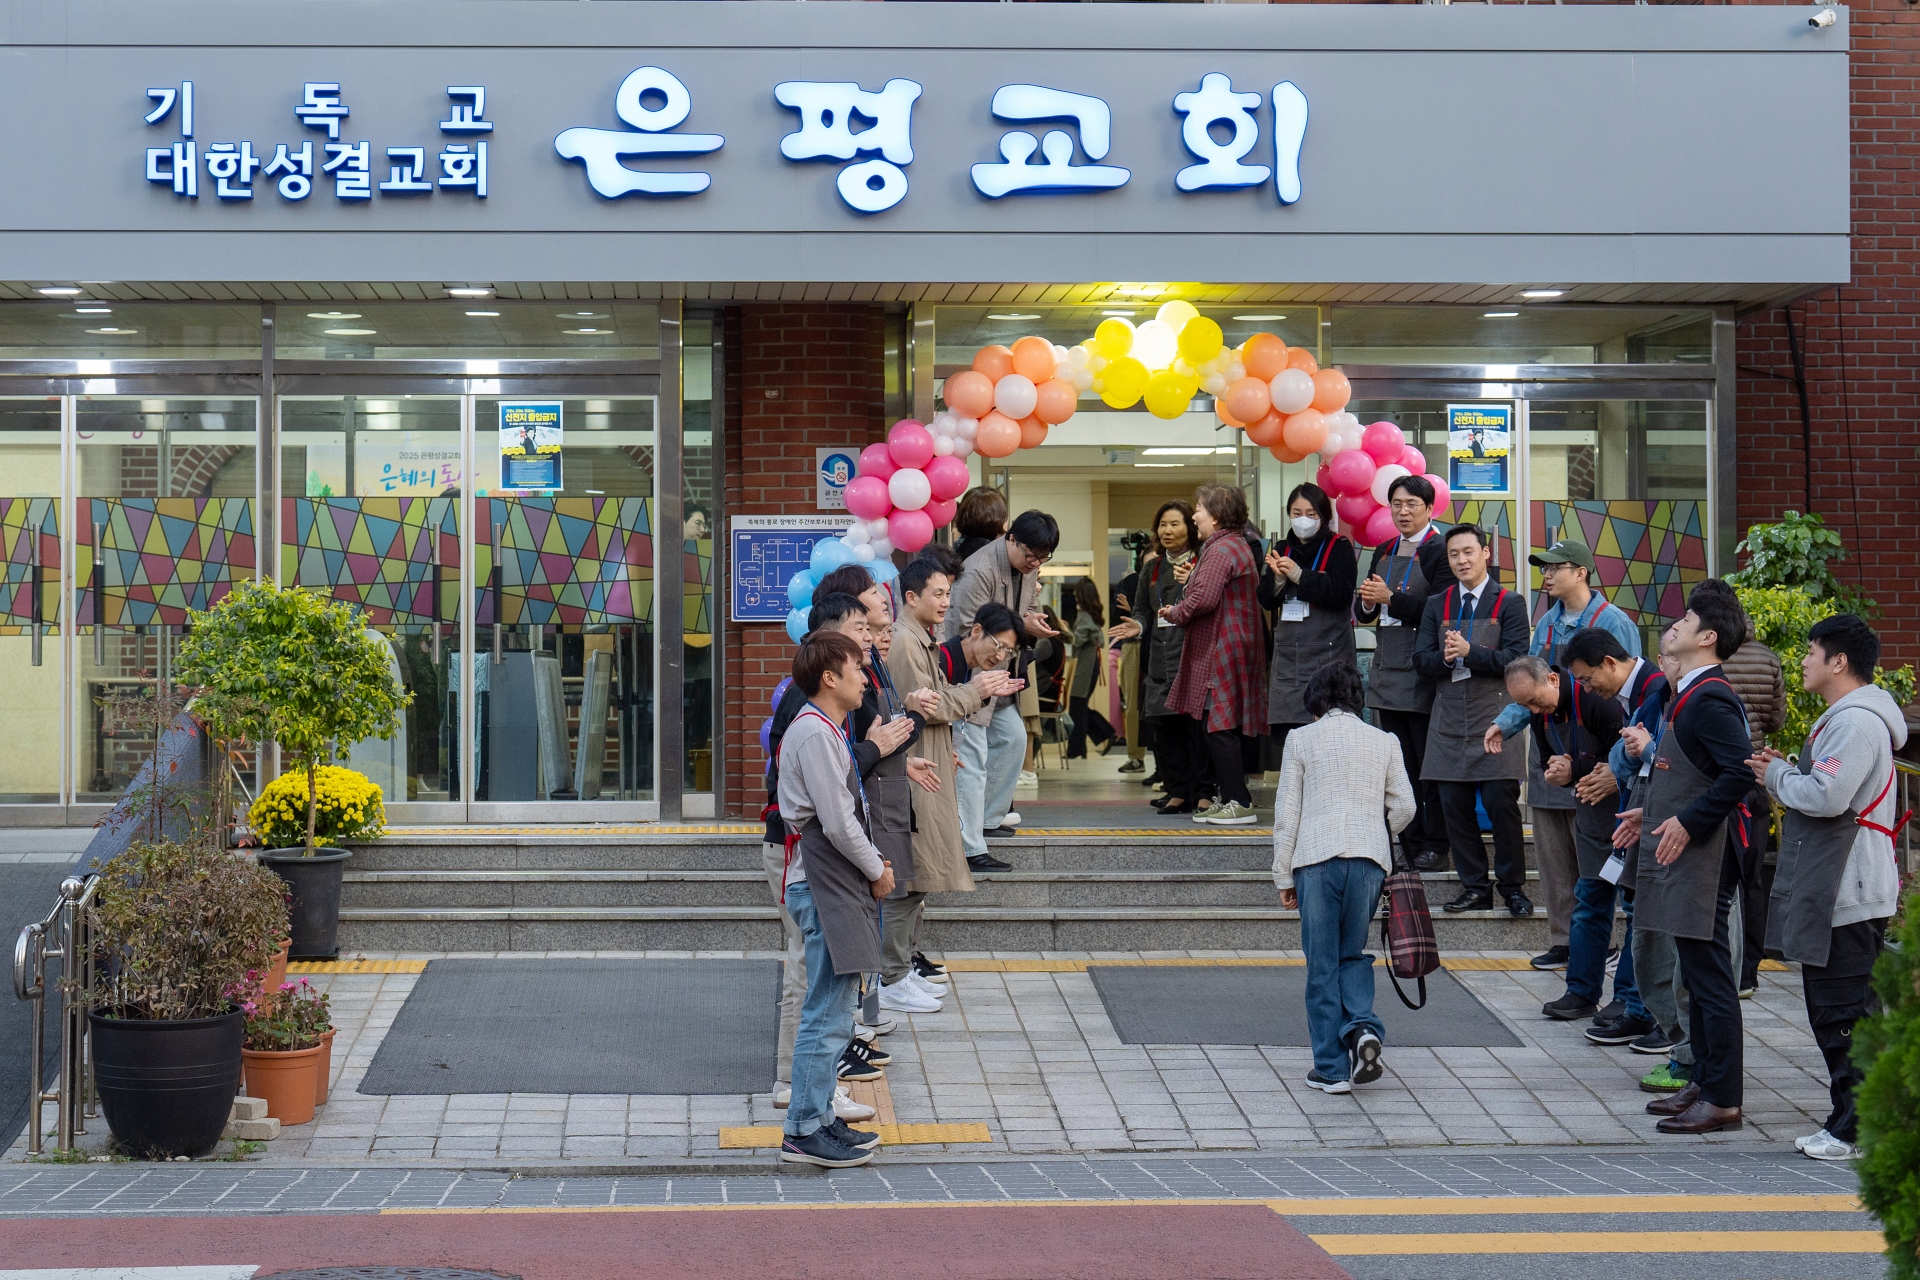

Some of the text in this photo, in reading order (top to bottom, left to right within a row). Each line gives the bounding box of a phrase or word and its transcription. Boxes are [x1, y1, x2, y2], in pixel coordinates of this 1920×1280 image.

[553, 65, 1310, 215] 은평교회
[145, 140, 489, 201] 대한성결교회
[505, 412, 557, 422] 신천지 출입금지
[1454, 416, 1504, 425] 신천지 출입금지
[380, 463, 436, 492] 은혜의
[440, 463, 480, 489] 동
